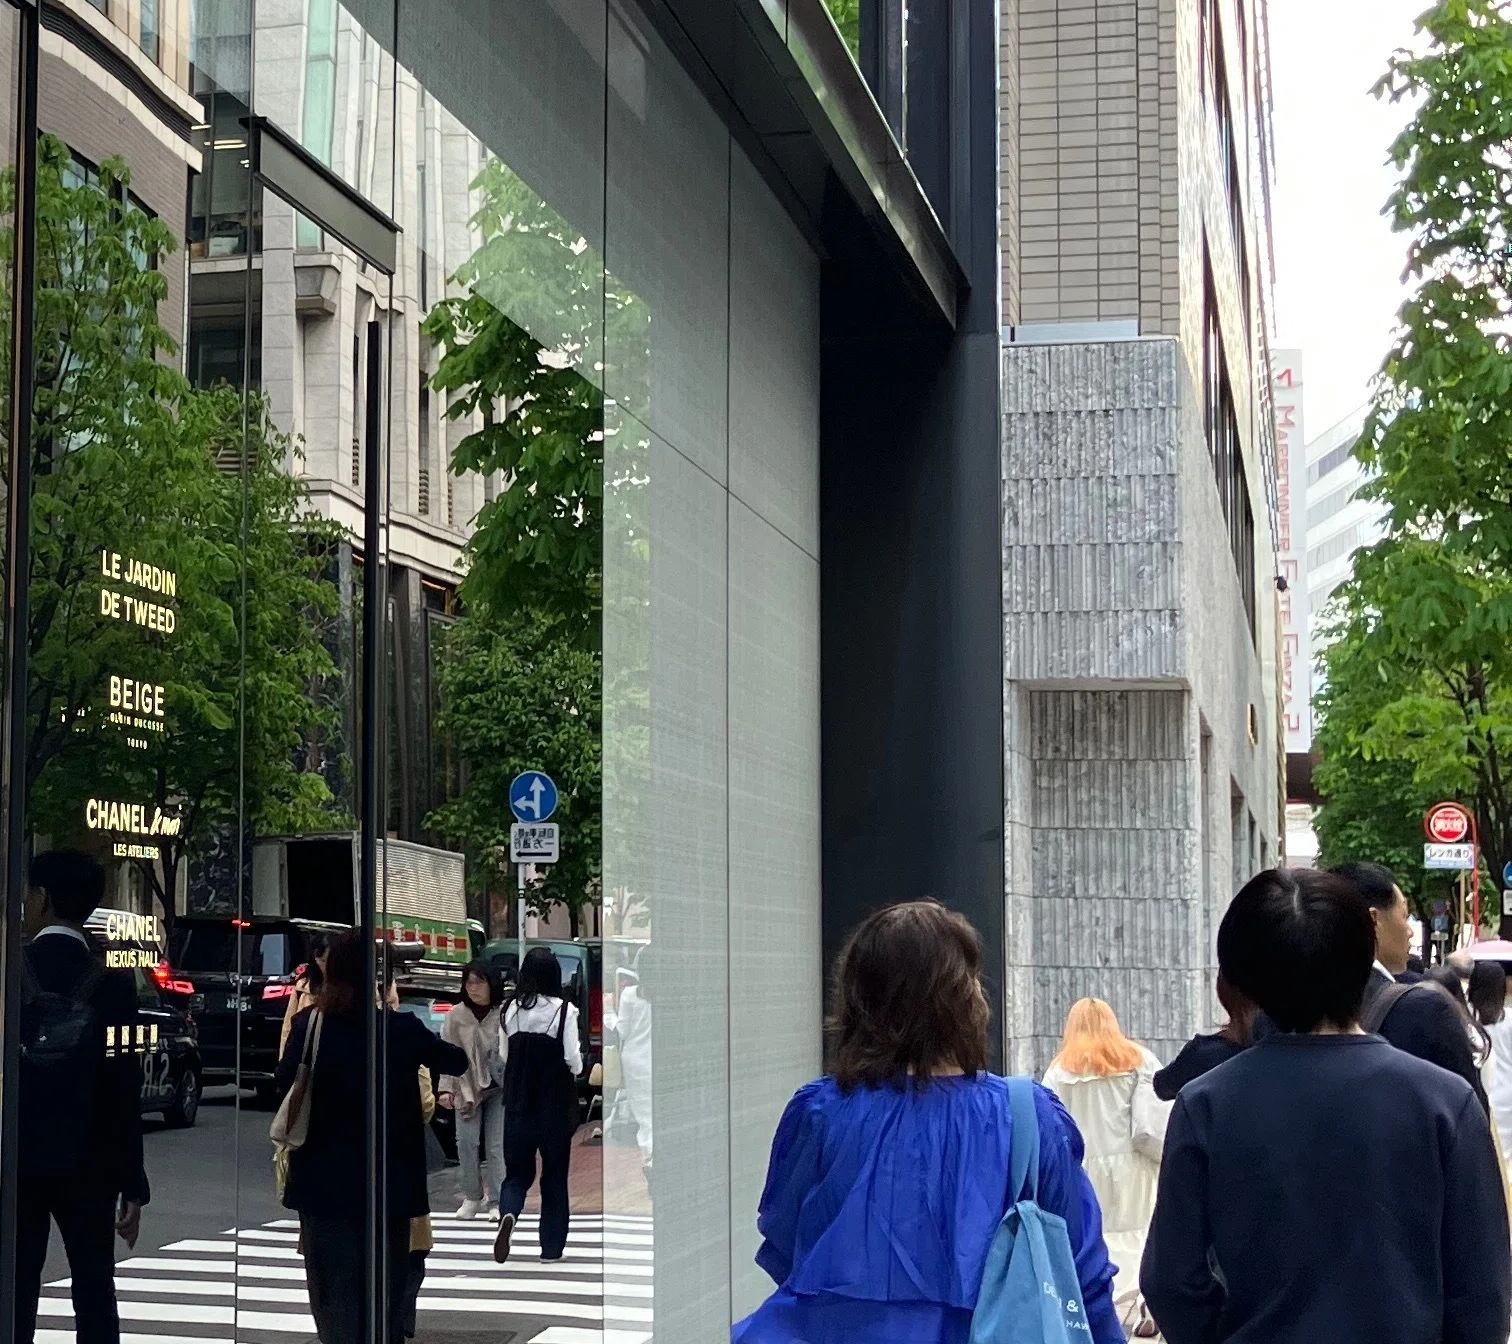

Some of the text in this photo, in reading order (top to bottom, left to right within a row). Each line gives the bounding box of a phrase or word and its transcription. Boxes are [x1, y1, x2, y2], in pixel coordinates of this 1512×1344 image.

[101, 549, 177, 597] LE JARDIN
[100, 588, 176, 634] DE TWEED
[109, 674, 165, 717] BEIGE
[86, 798, 149, 835] CHANEL
[113, 842, 160, 861] LES ATELIERS
[106, 913, 161, 943] CHANEL
[106, 949, 160, 969] NEXUS HALL
[1066, 1299, 1079, 1313] &
